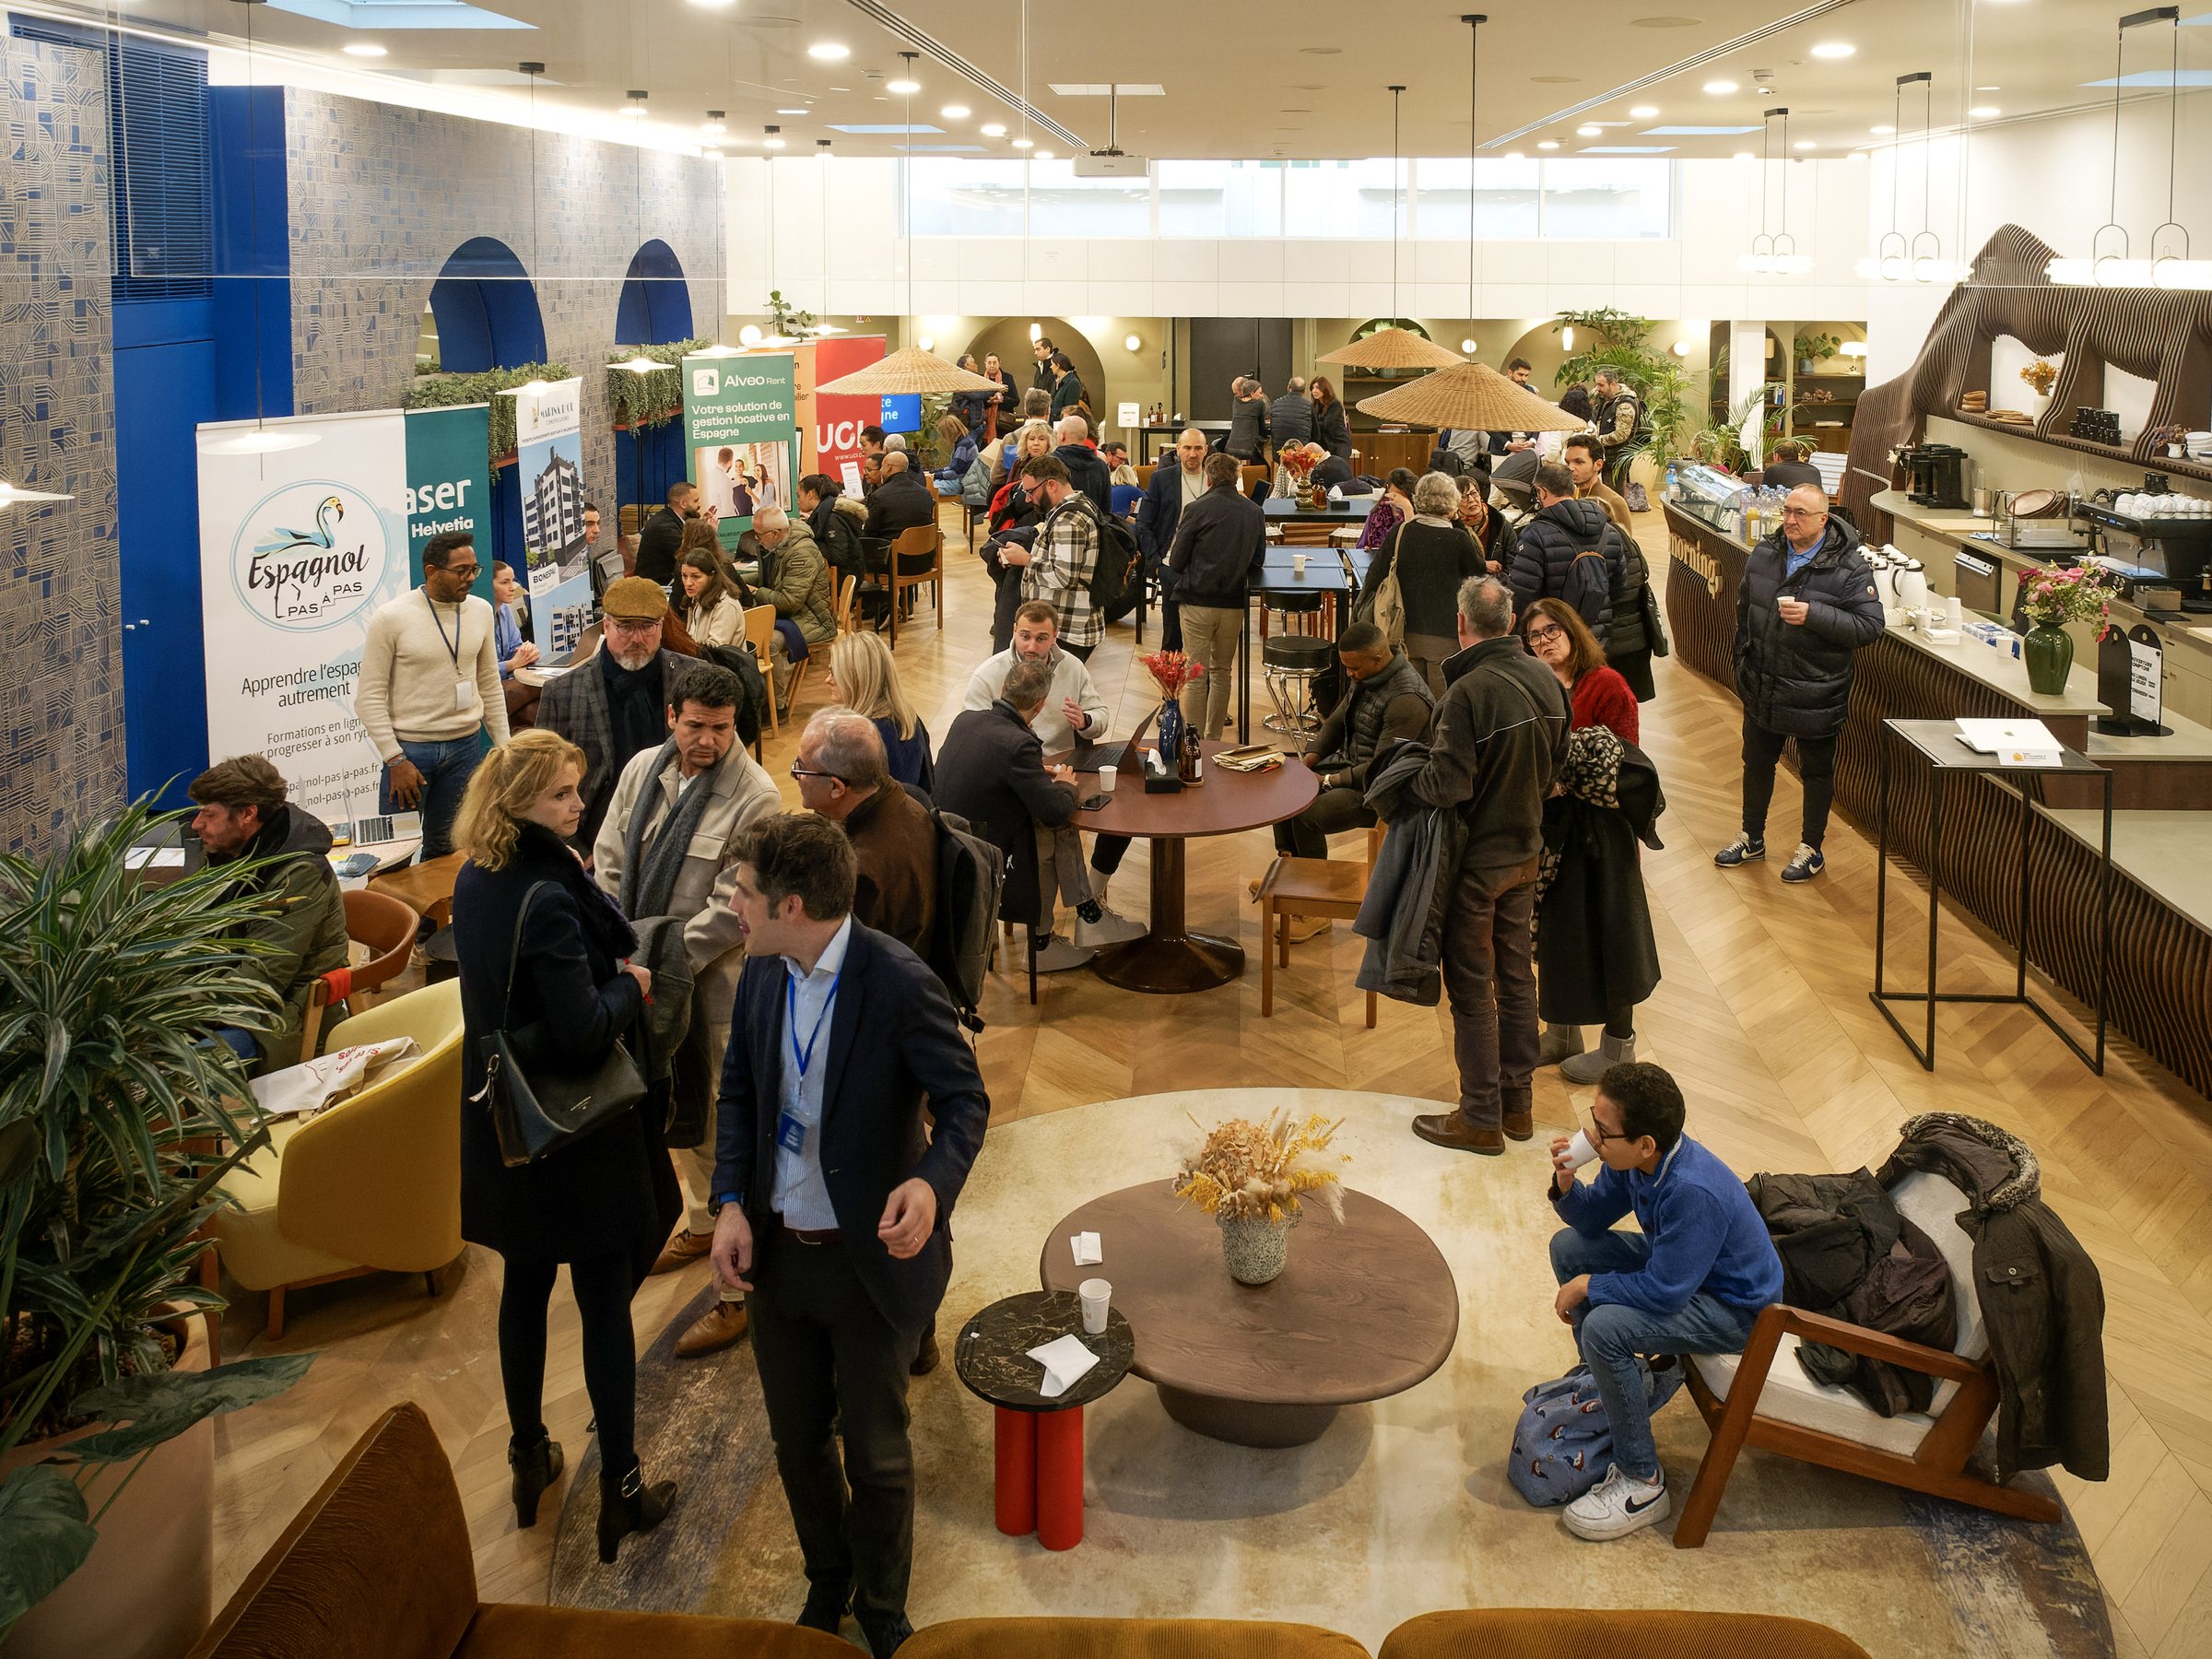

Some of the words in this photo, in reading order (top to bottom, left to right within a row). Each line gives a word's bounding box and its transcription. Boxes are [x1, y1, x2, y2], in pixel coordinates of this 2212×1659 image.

[724, 375, 765, 387] Alveo
[691, 405, 724, 415] Votre
[725, 402, 768, 412] solution
[769, 400, 782, 409] de
[692, 417, 733, 429] gestion
[735, 413, 775, 425] locative
[777, 413, 790, 422] en
[692, 429, 740, 441] Espagne
[817, 420, 864, 453] UCI
[406, 479, 472, 515] aser
[411, 516, 474, 538] Helvetia
[248, 544, 371, 597] Espagnol
[1668, 533, 1720, 599] morning
[288, 603, 319, 617] PAS
[322, 592, 331, 604] À
[333, 582, 362, 595] PAS
[241, 667, 317, 698] Apprendre
[320, 661, 361, 681] l'espa
[278, 680, 351, 707] autrement
[267, 724, 326, 745] Formations
[328, 722, 341, 733] en
[343, 717, 361, 731] lign
[267, 738, 322, 761] progresser
[324, 735, 331, 747] à
[334, 733, 351, 745] son
[354, 728, 370, 743] ryt
